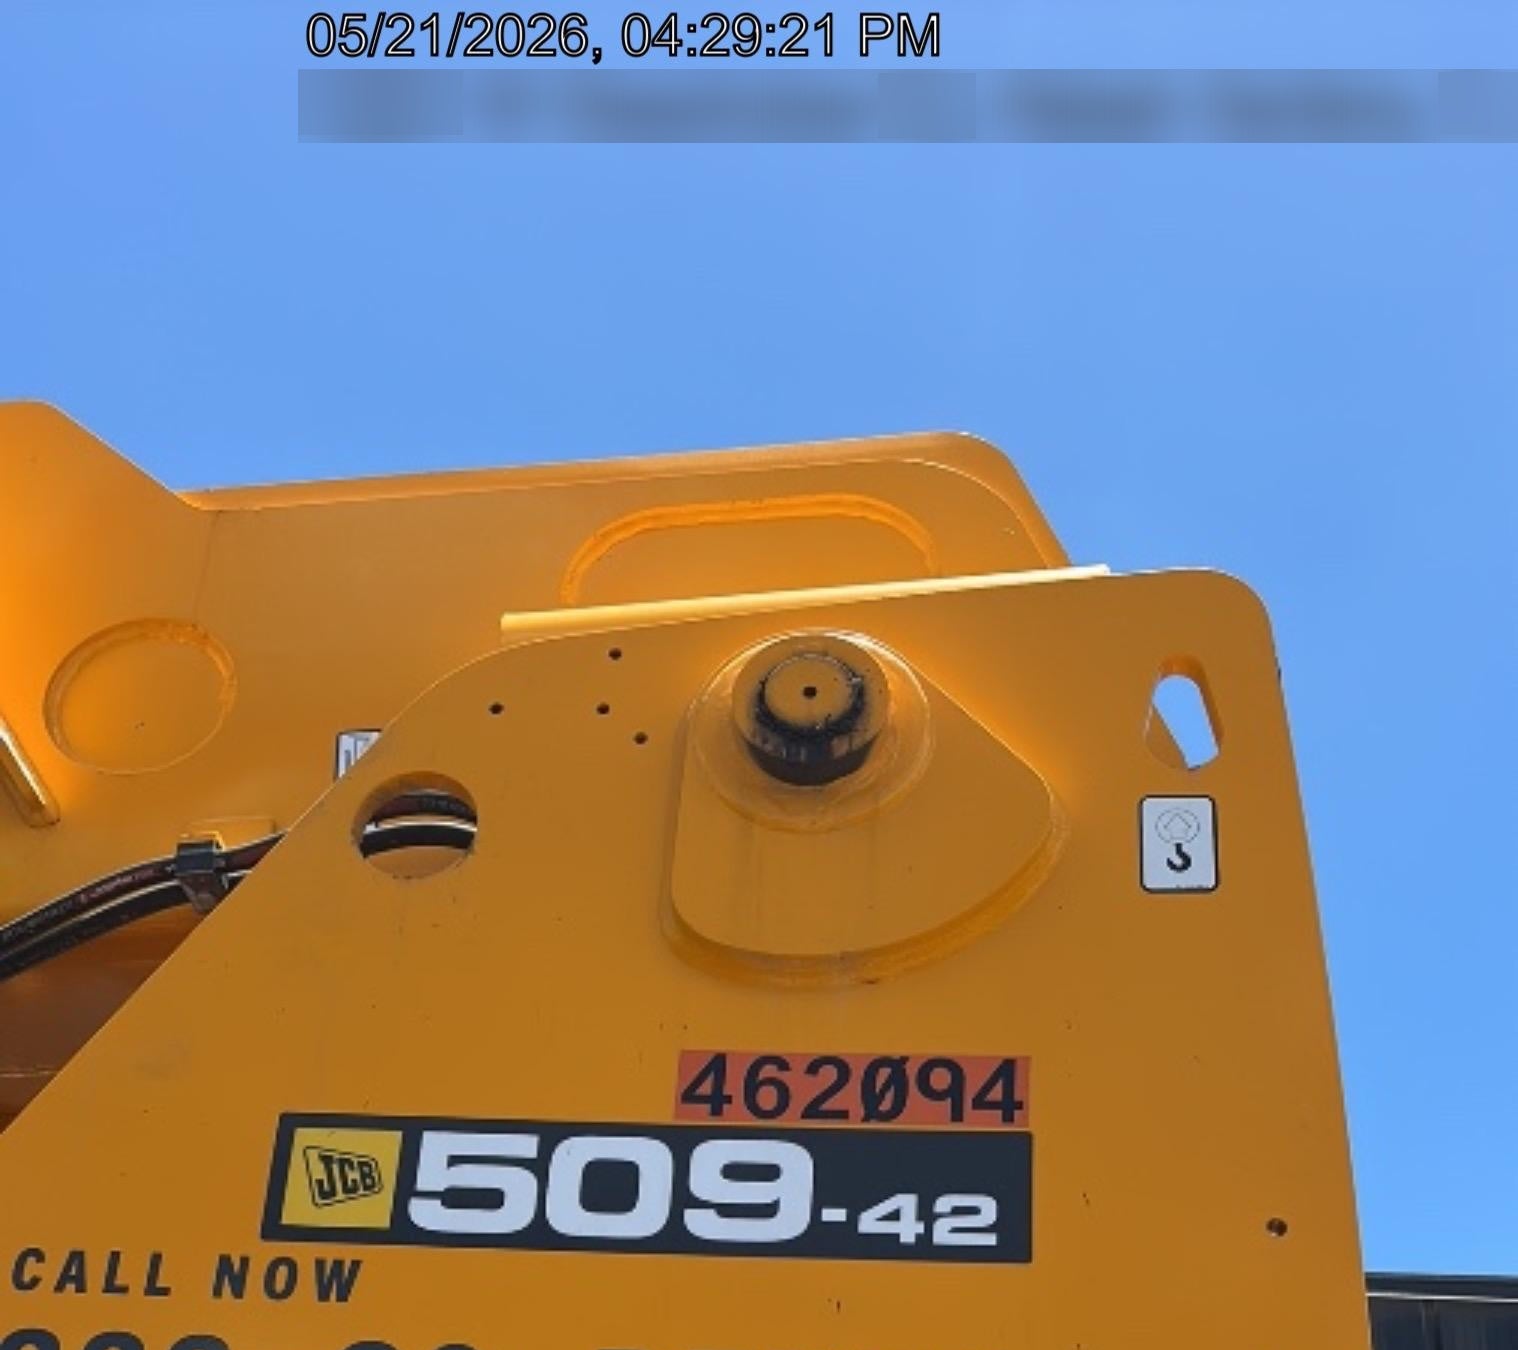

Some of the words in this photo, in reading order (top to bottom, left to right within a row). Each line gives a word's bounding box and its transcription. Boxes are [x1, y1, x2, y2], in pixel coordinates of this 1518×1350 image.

[680, 1053, 1024, 1124] 462094
[314, 1153, 377, 1201] JCB
[407, 1130, 999, 1247] 509-42
[11, 1247, 172, 1297] CALL
[212, 1253, 363, 1303] NOW
